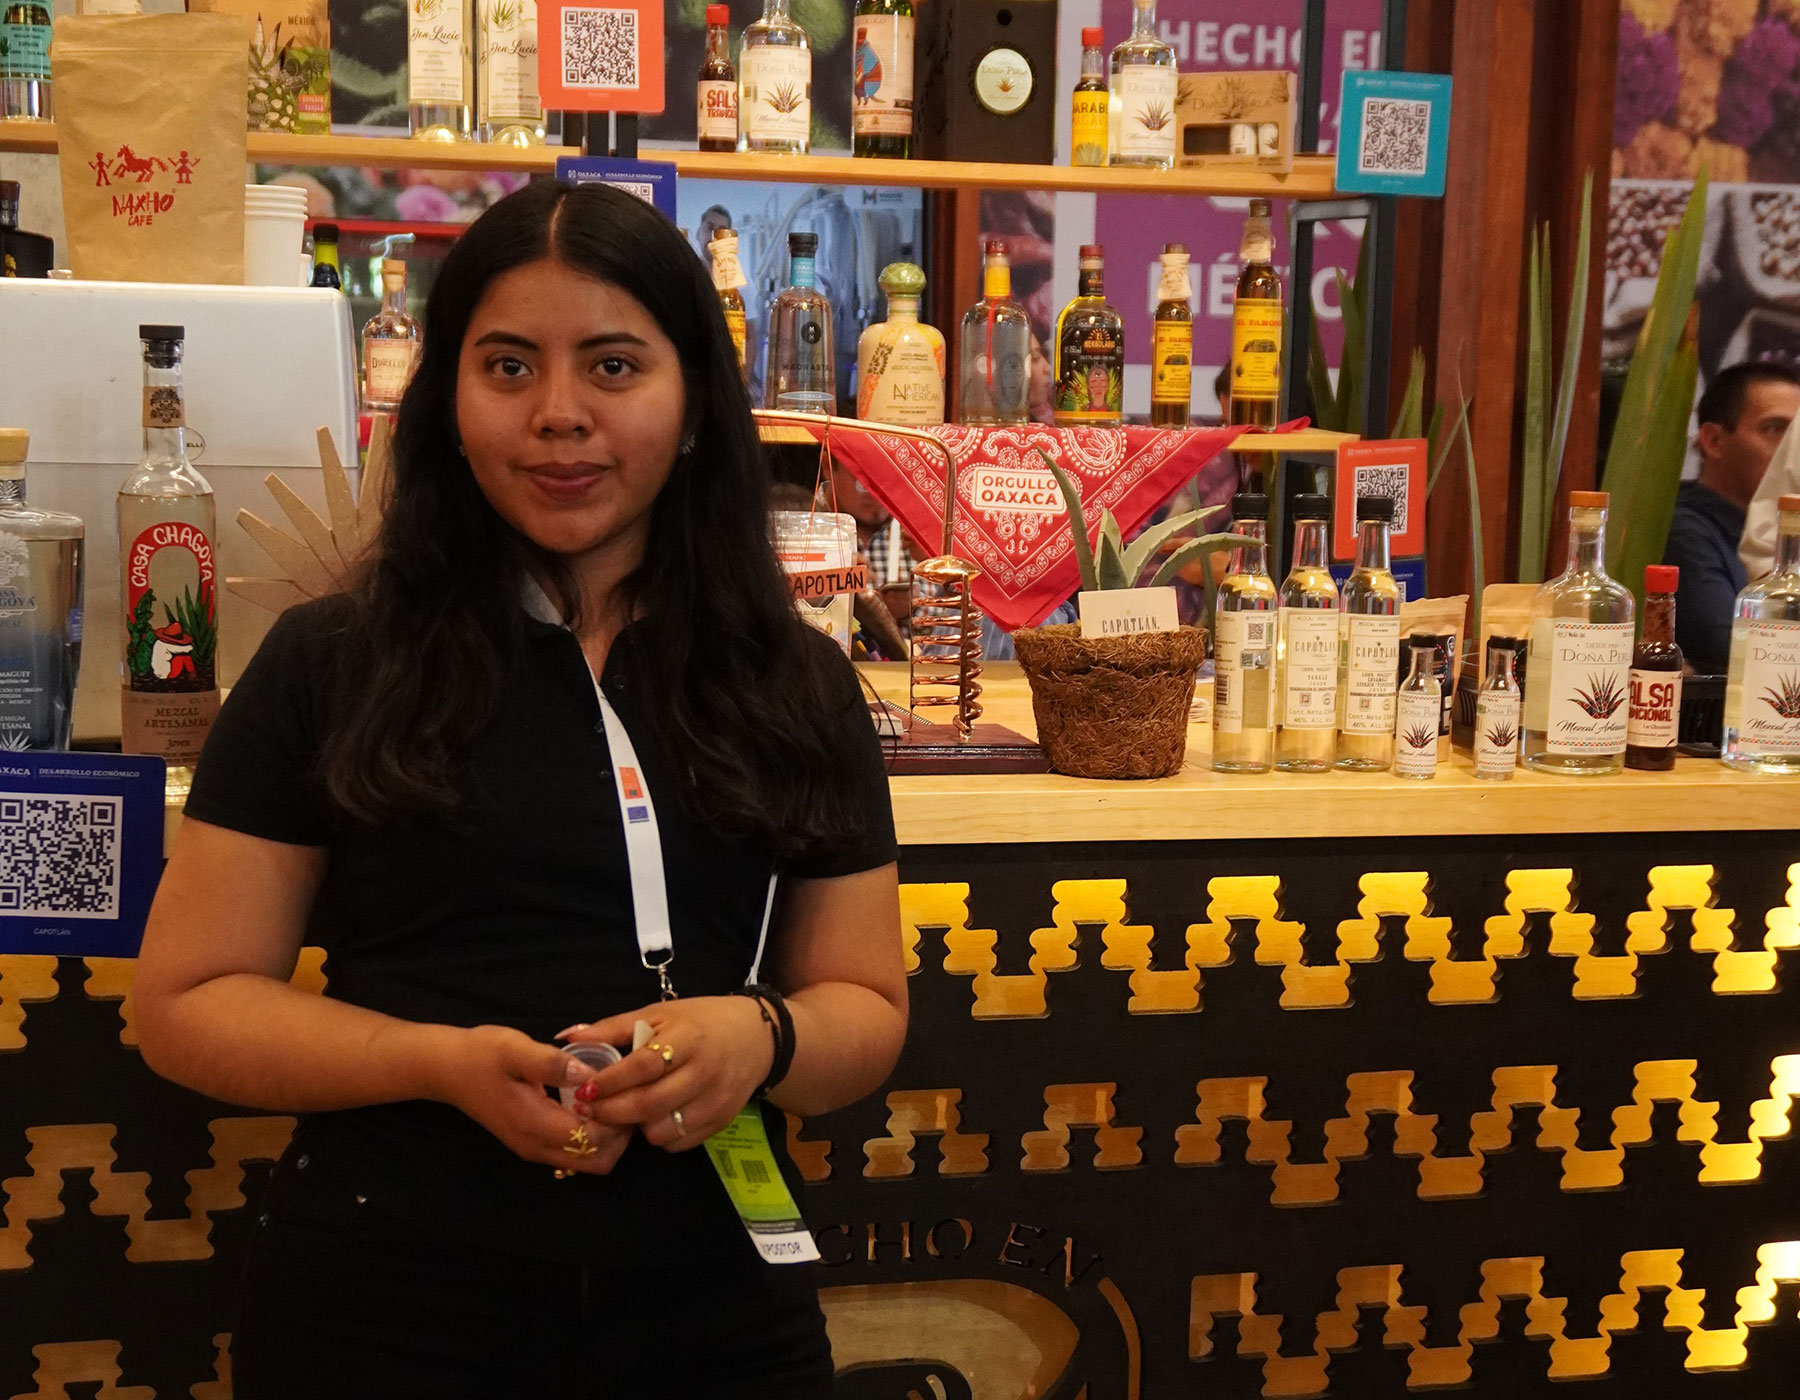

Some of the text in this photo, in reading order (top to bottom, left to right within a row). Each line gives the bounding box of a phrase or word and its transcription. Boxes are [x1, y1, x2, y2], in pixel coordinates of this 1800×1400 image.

[982, 475, 1058, 491] ORGULLO
[981, 489, 1058, 506] OAXACA
[131, 525, 213, 587] CASA CHAGOYA
[793, 568, 864, 596] APOTLÁN
[1629, 680, 1675, 708] ALSA
[154, 707, 200, 717] MEZCAL
[1629, 706, 1673, 722] DICIONAL
[144, 718, 210, 729] ARTESANAL
[1556, 719, 1597, 734] Mezcal
[39, 768, 92, 777] DESARROLLO
[92, 769, 140, 778] ECONÓMICO
[762, 1241, 803, 1256] XPOSITOR
